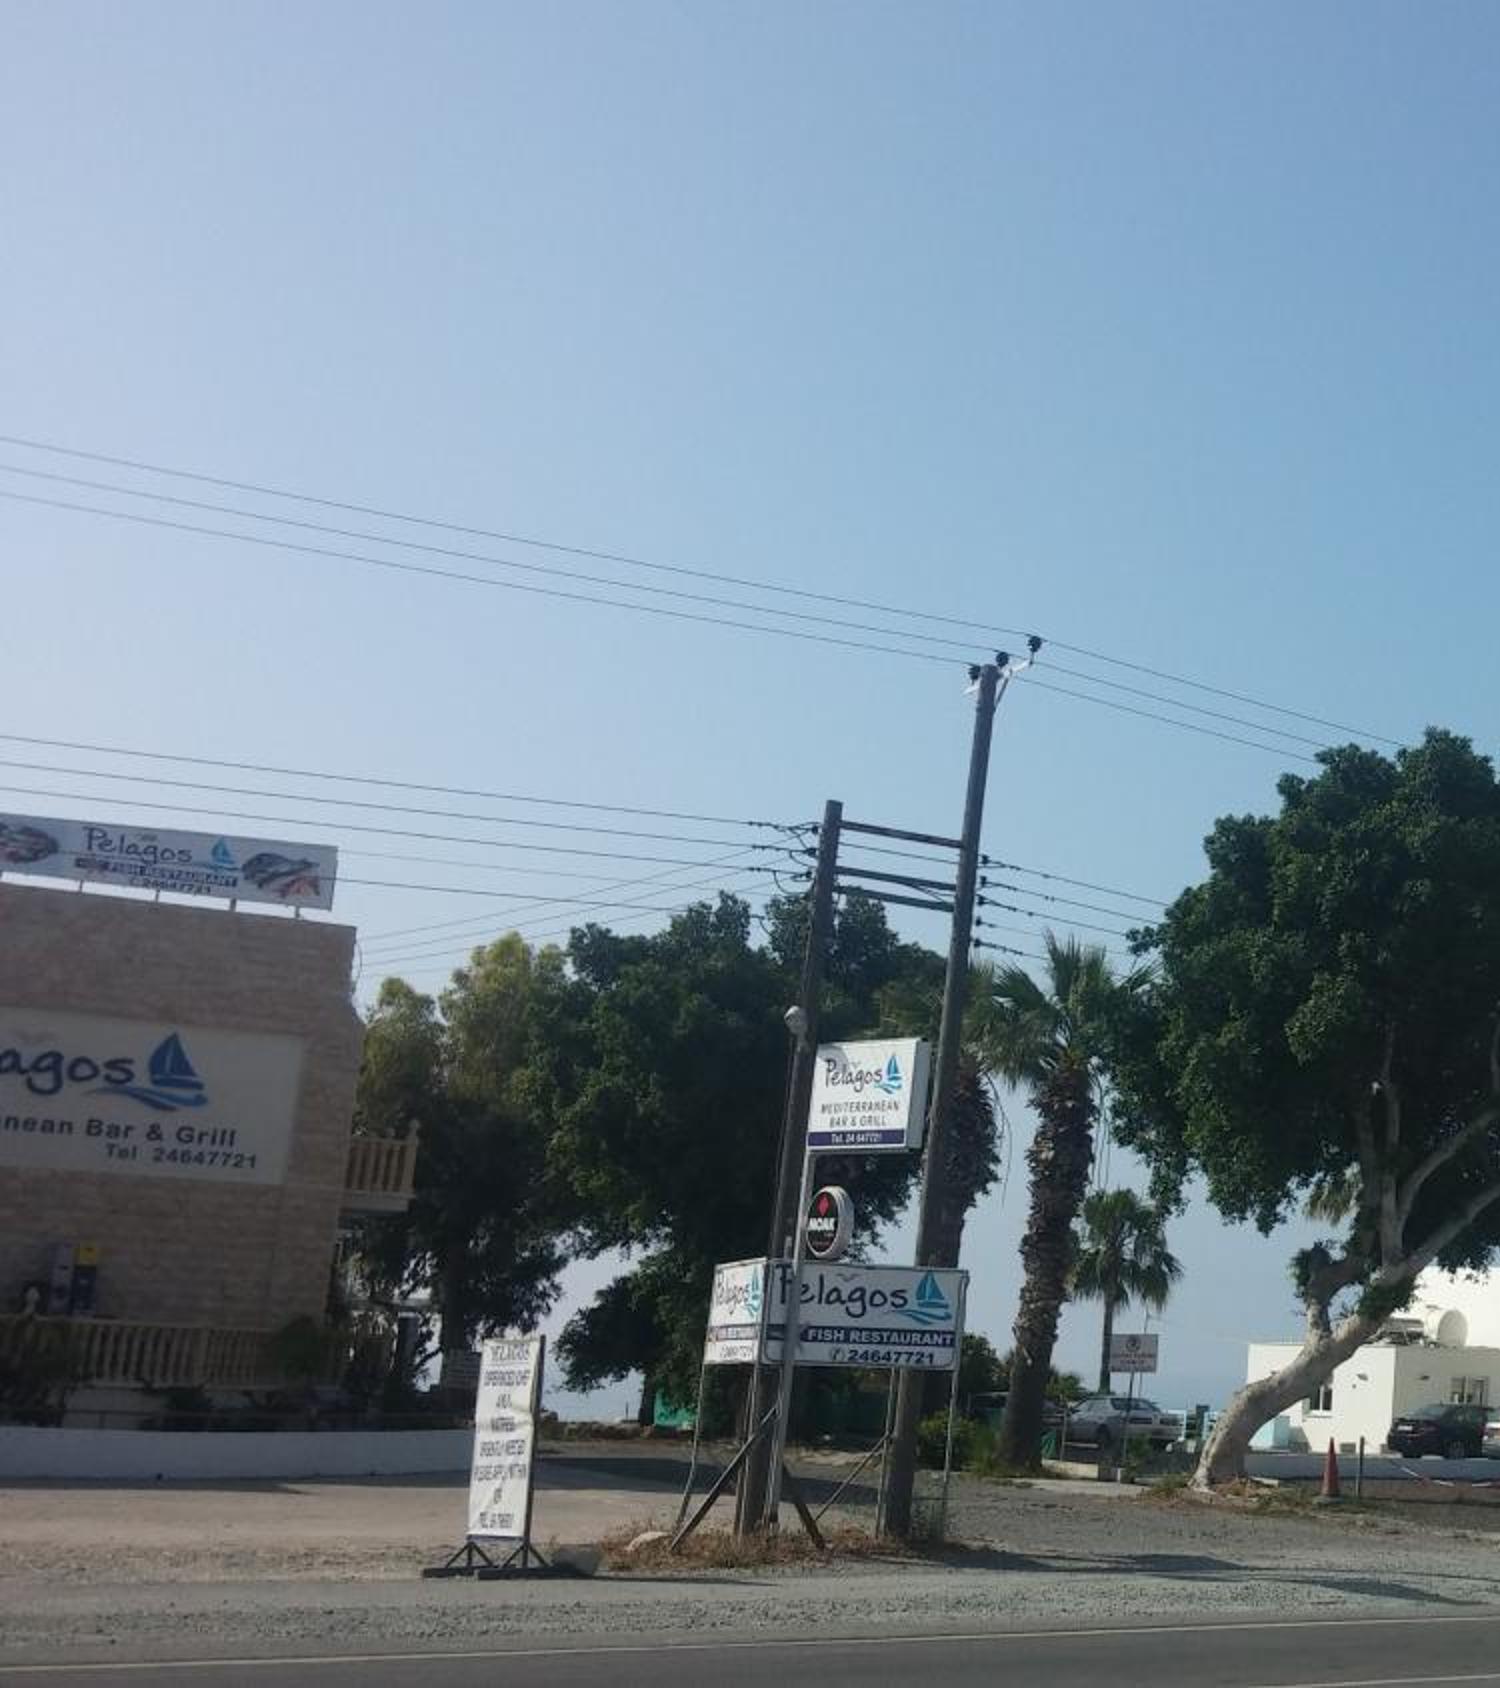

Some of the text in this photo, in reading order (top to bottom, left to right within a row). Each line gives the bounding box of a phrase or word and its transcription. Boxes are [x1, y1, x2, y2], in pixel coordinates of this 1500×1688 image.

[83, 826, 193, 864] Pelagos
[0, 1048, 135, 1095] agos
[823, 1058, 883, 1092] Pelagos
[821, 1100, 899, 1114] MEDITERRANEAN
[86, 1119, 134, 1139] Bar
[146, 1123, 163, 1141] &
[176, 1125, 237, 1147] Grill
[830, 1117, 848, 1128] BAR
[860, 1115, 886, 1126] GRILL
[106, 1143, 257, 1168] Tel 24647721
[808, 1327, 953, 1346] FISH RESTAURANT
[847, 1350, 934, 1364] 24647721
